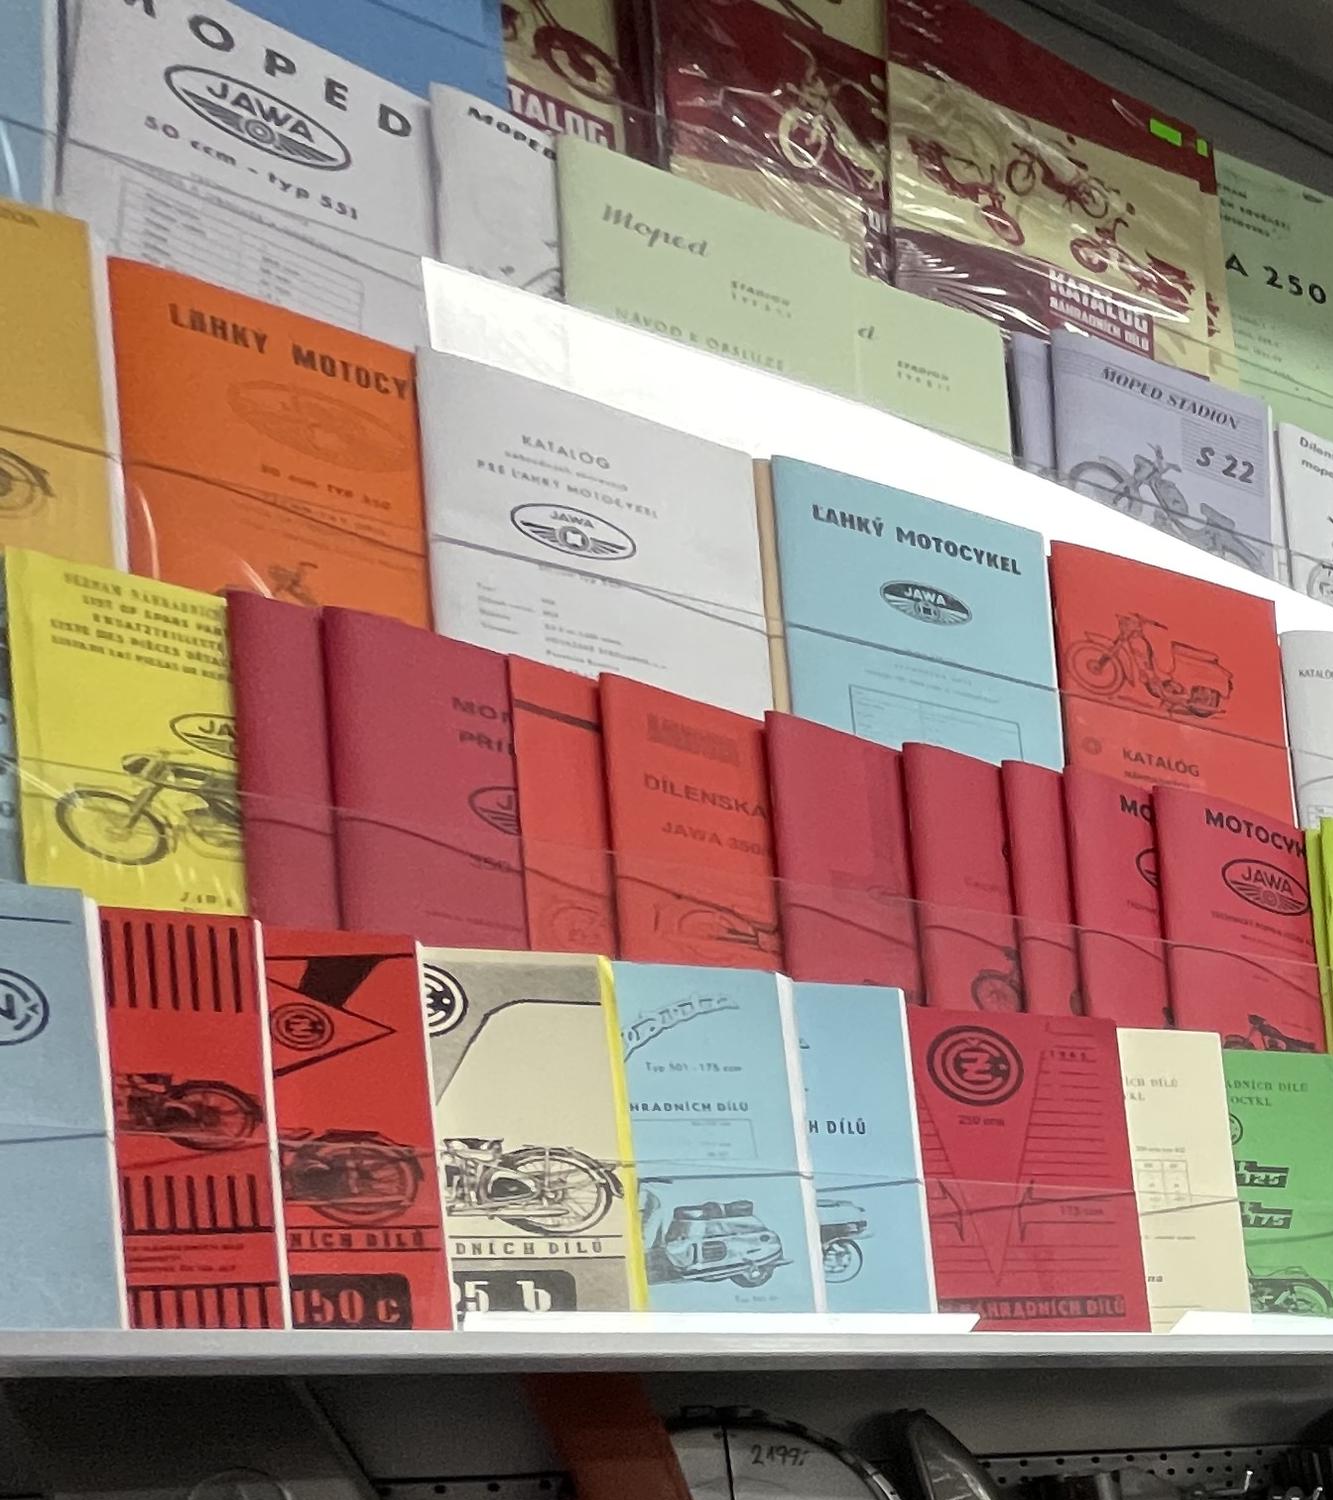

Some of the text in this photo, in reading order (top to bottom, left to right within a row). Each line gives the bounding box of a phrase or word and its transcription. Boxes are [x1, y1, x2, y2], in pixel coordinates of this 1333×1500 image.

[206, 82, 315, 143] JAWA
[144, 115, 180, 140] 50
[190, 140, 237, 166] ccm
[268, 172, 310, 200] typ
[320, 195, 358, 221] 551
[603, 203, 709, 257] Moped
[1263, 265, 1327, 304] 250
[1102, 365, 1241, 430] MOPED STADION
[521, 435, 610, 470] KATALOG
[1196, 446, 1255, 484] S 22
[550, 511, 594, 529] JAWA
[896, 526, 1022, 576] MOTOCYKEL
[904, 587, 947, 605] JAWA
[662, 820, 724, 848] JAWA
[1241, 866, 1295, 896] JAWA
[827, 1117, 867, 1135] DÍLŮ
[455, 1240, 536, 1256] DNÍCH
